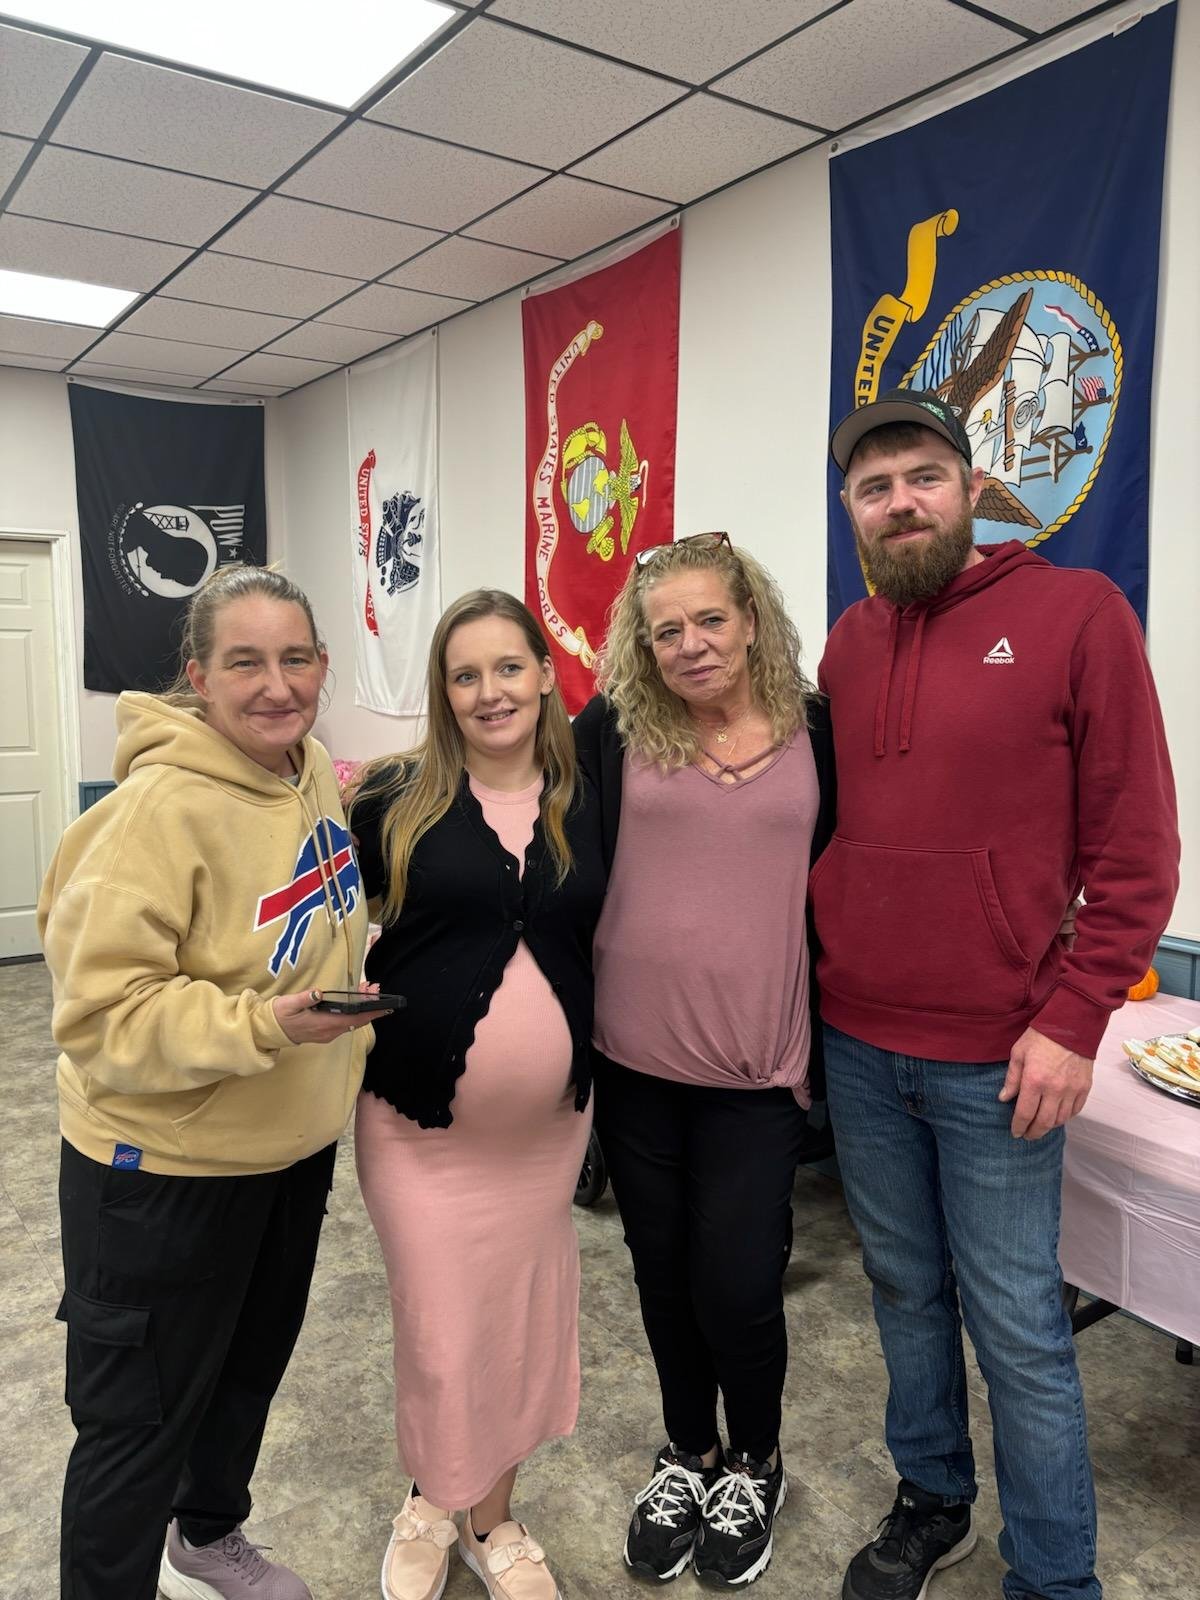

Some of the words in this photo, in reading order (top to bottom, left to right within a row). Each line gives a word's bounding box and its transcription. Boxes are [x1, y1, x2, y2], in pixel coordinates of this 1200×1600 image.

[550, 342, 580, 403] UNITED
[858, 315, 895, 406] UNITED
[539, 415, 557, 485] STATES
[359, 468, 370, 517] UNITED
[188, 504, 245, 547] POW
[537, 497, 555, 562] MARINE
[537, 577, 567, 638] CORPS
[983, 656, 1015, 664] Reebok
